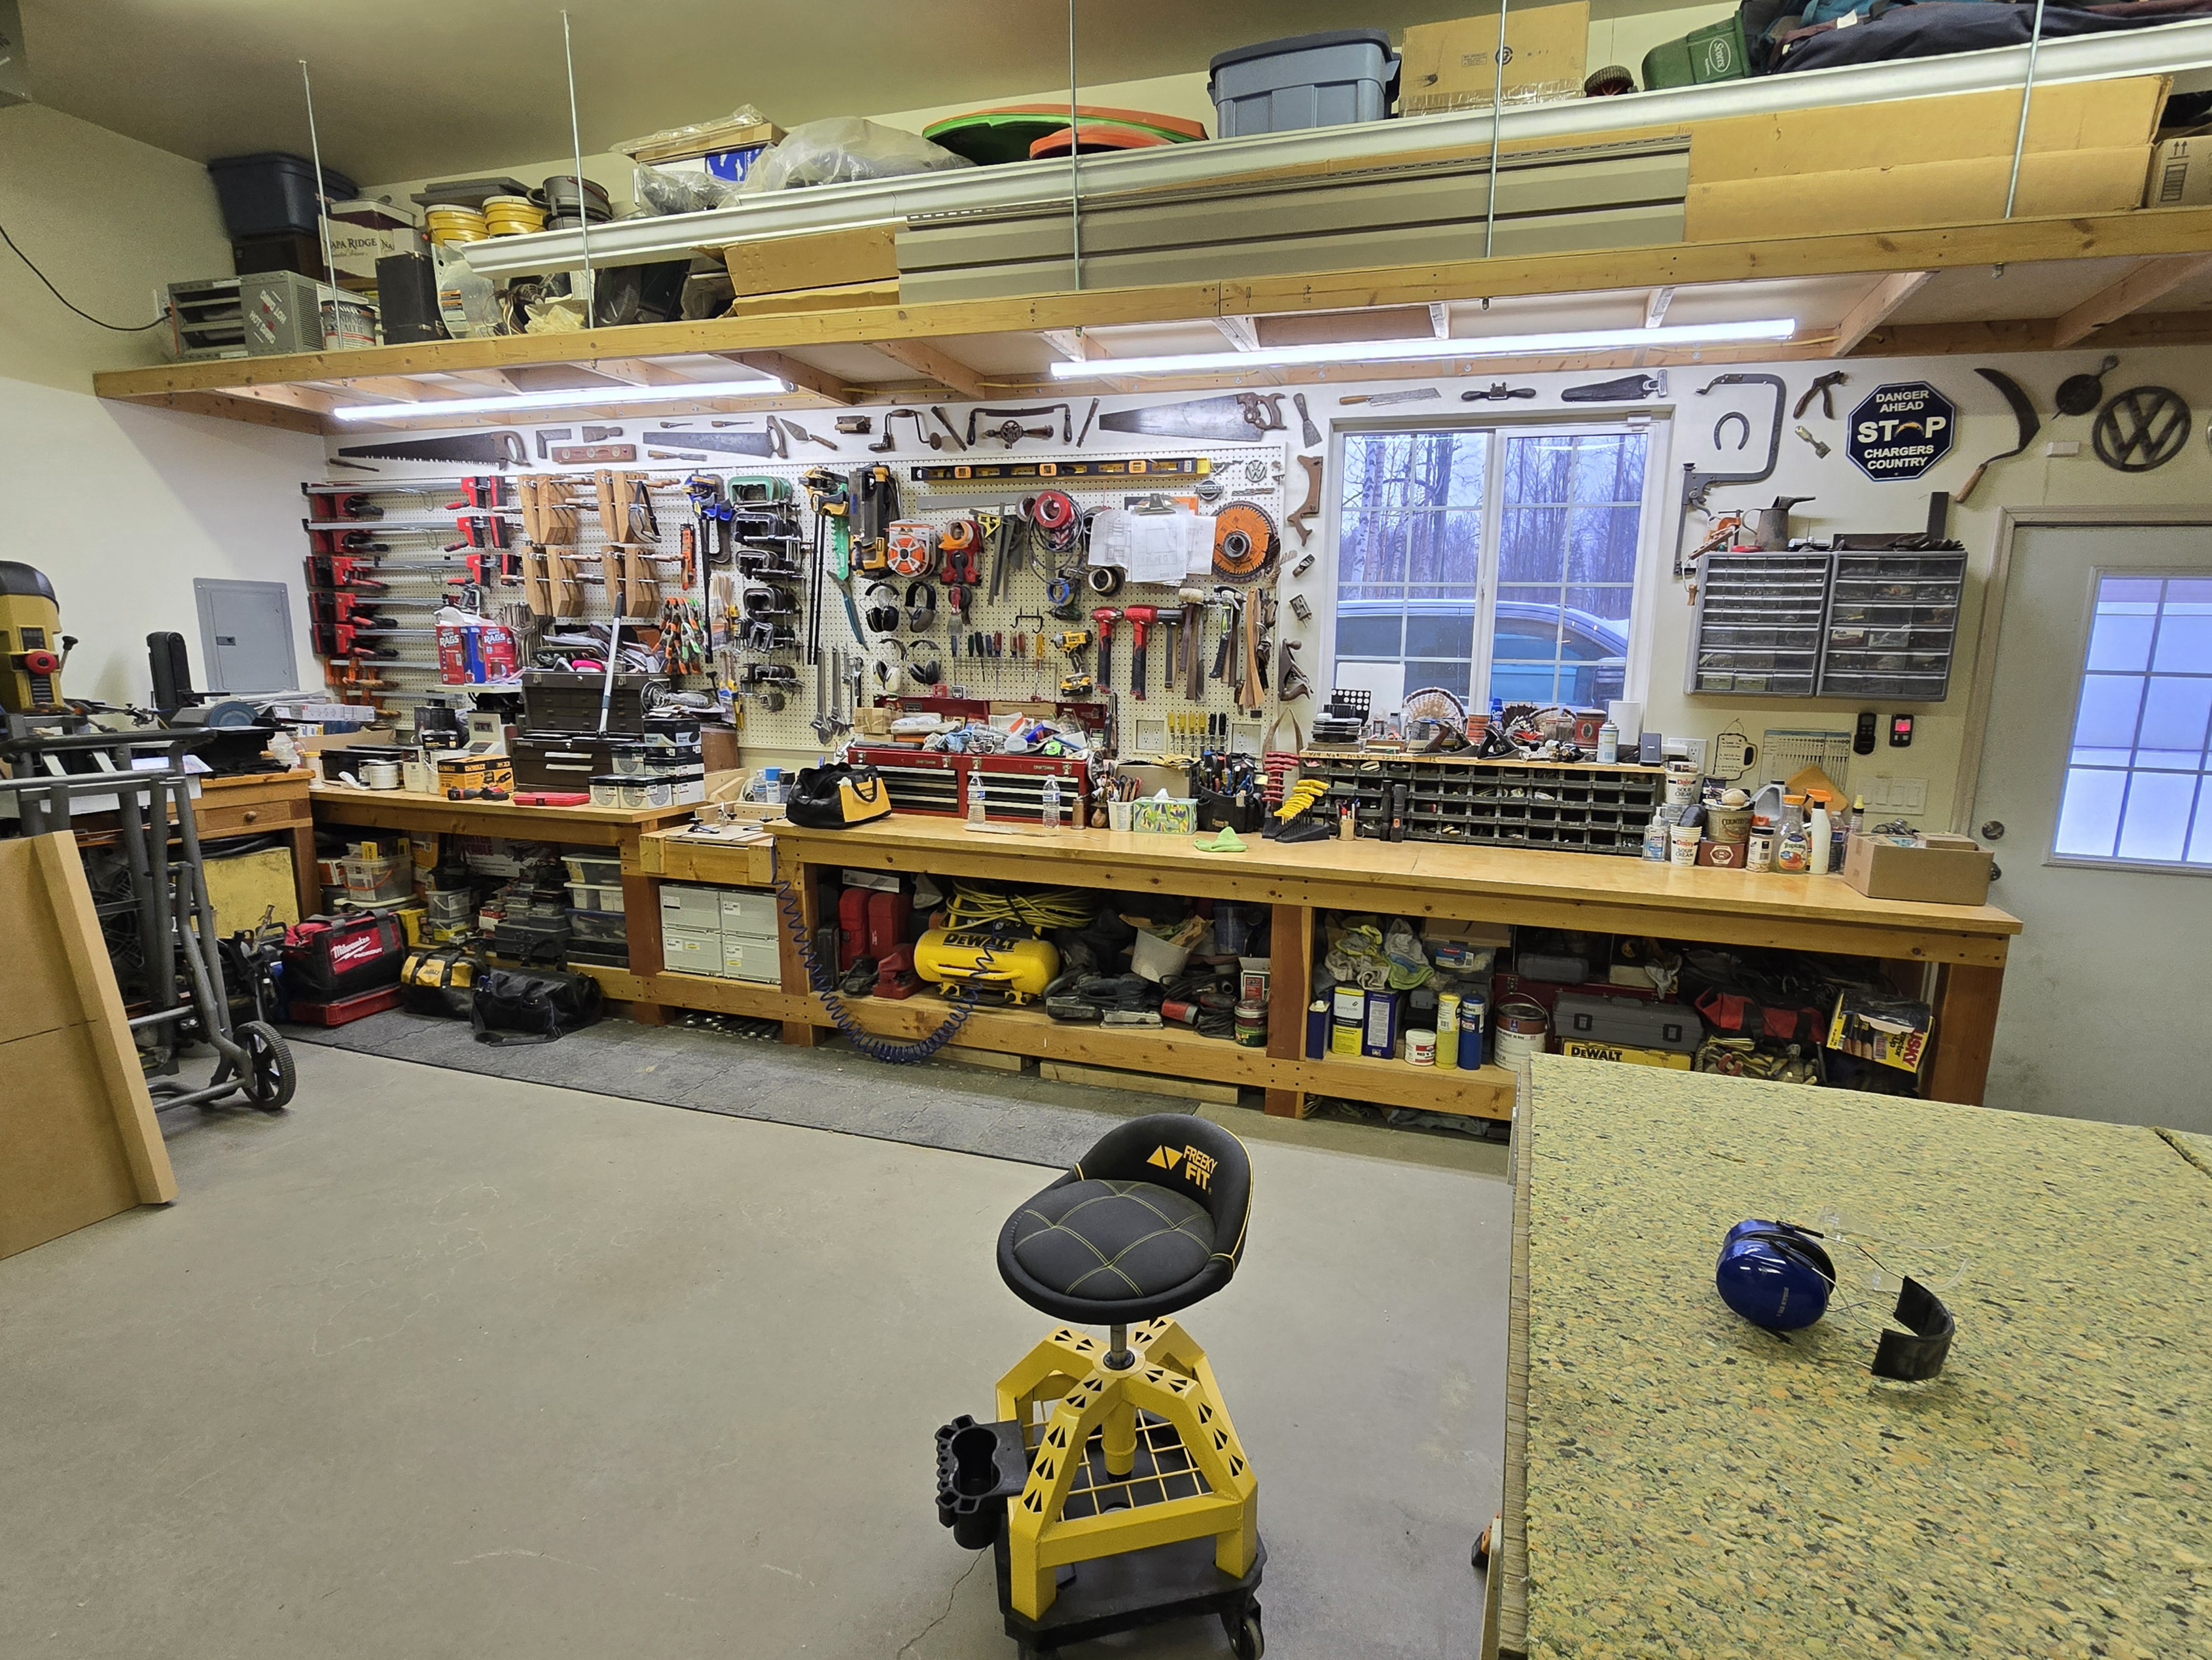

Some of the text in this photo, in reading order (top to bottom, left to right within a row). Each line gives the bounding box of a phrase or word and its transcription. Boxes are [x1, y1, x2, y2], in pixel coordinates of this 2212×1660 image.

[1714, 43, 1725, 68] Scotts
[347, 238, 378, 249] RIDGE
[1876, 390, 1929, 403] DANGER
[1880, 401, 1924, 413] AHEAD
[1864, 444, 1935, 459] CHARGERS
[1867, 456, 1929, 470] COUNTRY
[439, 634, 459, 647] RAGS
[484, 632, 507, 645] RAGS
[1676, 840, 1694, 848] Daisy
[330, 936, 370, 959] Milwaukee
[1902, 1028, 1924, 1068] USKY
[1183, 1145, 1218, 1174] FREEKY
[1185, 1161, 1211, 1191] FIT
